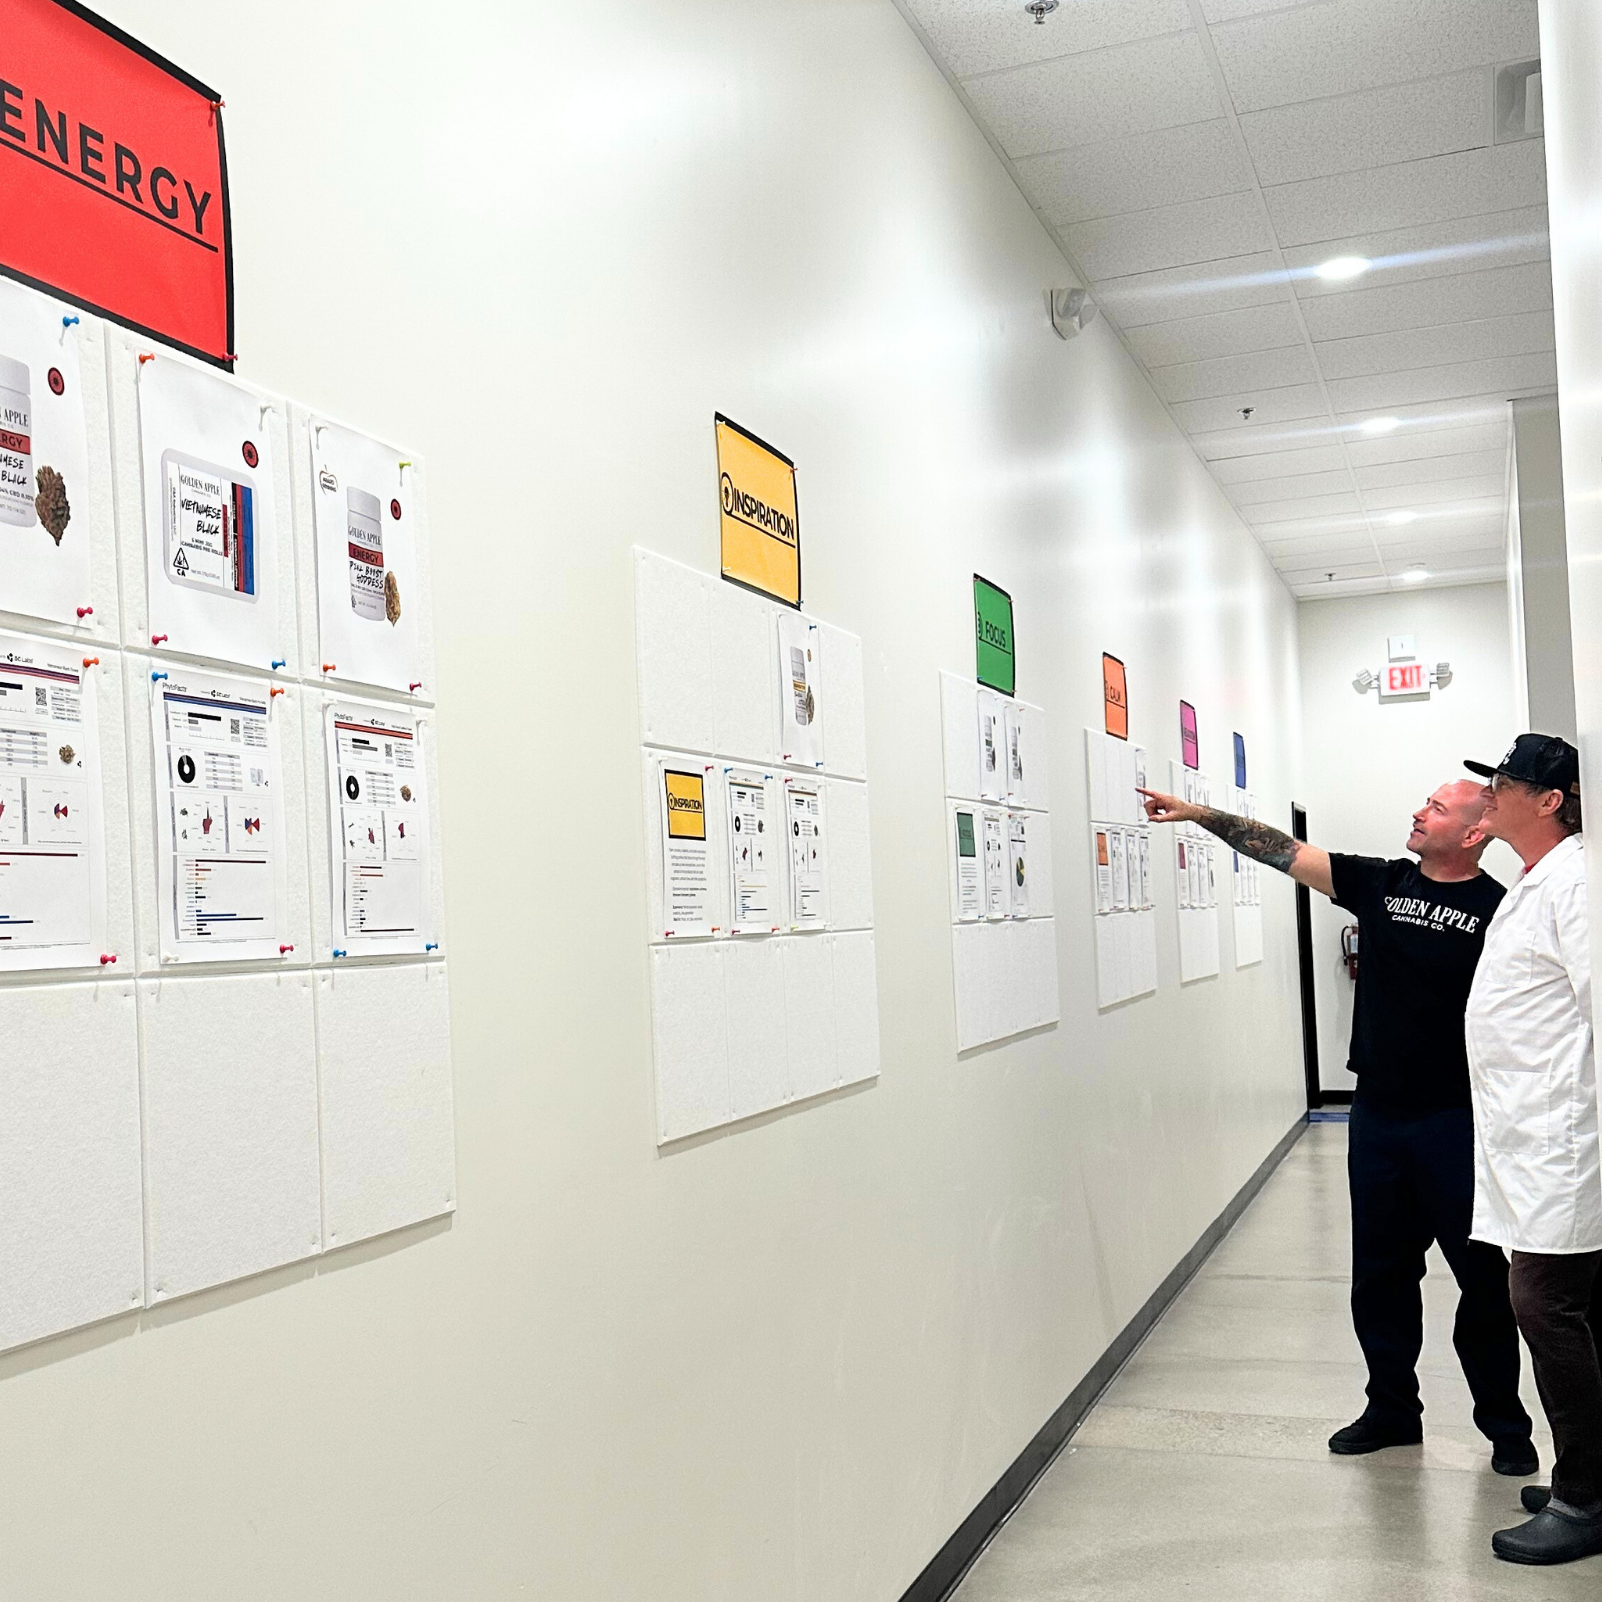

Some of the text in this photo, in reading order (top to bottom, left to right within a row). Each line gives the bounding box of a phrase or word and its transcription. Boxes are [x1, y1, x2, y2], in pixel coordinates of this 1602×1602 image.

[0, 78, 212, 235] ENERGY
[4, 408, 29, 428] APPLE
[0, 430, 24, 449] RGY
[1, 470, 27, 487] BLACK
[180, 474, 221, 497] GOLDEN APPLE
[733, 487, 795, 541] INSPIRATION
[348, 525, 366, 541] GOLDEN
[367, 532, 382, 546] APPLE
[353, 547, 379, 564] ENERGY
[176, 568, 186, 577] CA
[985, 620, 1006, 649] FOCUS
[1388, 665, 1422, 691] EXIT
[674, 797, 702, 811] INSPIRATION
[1391, 914, 1445, 932] CANNABIS CO.
[1428, 904, 1480, 934] APPLE
